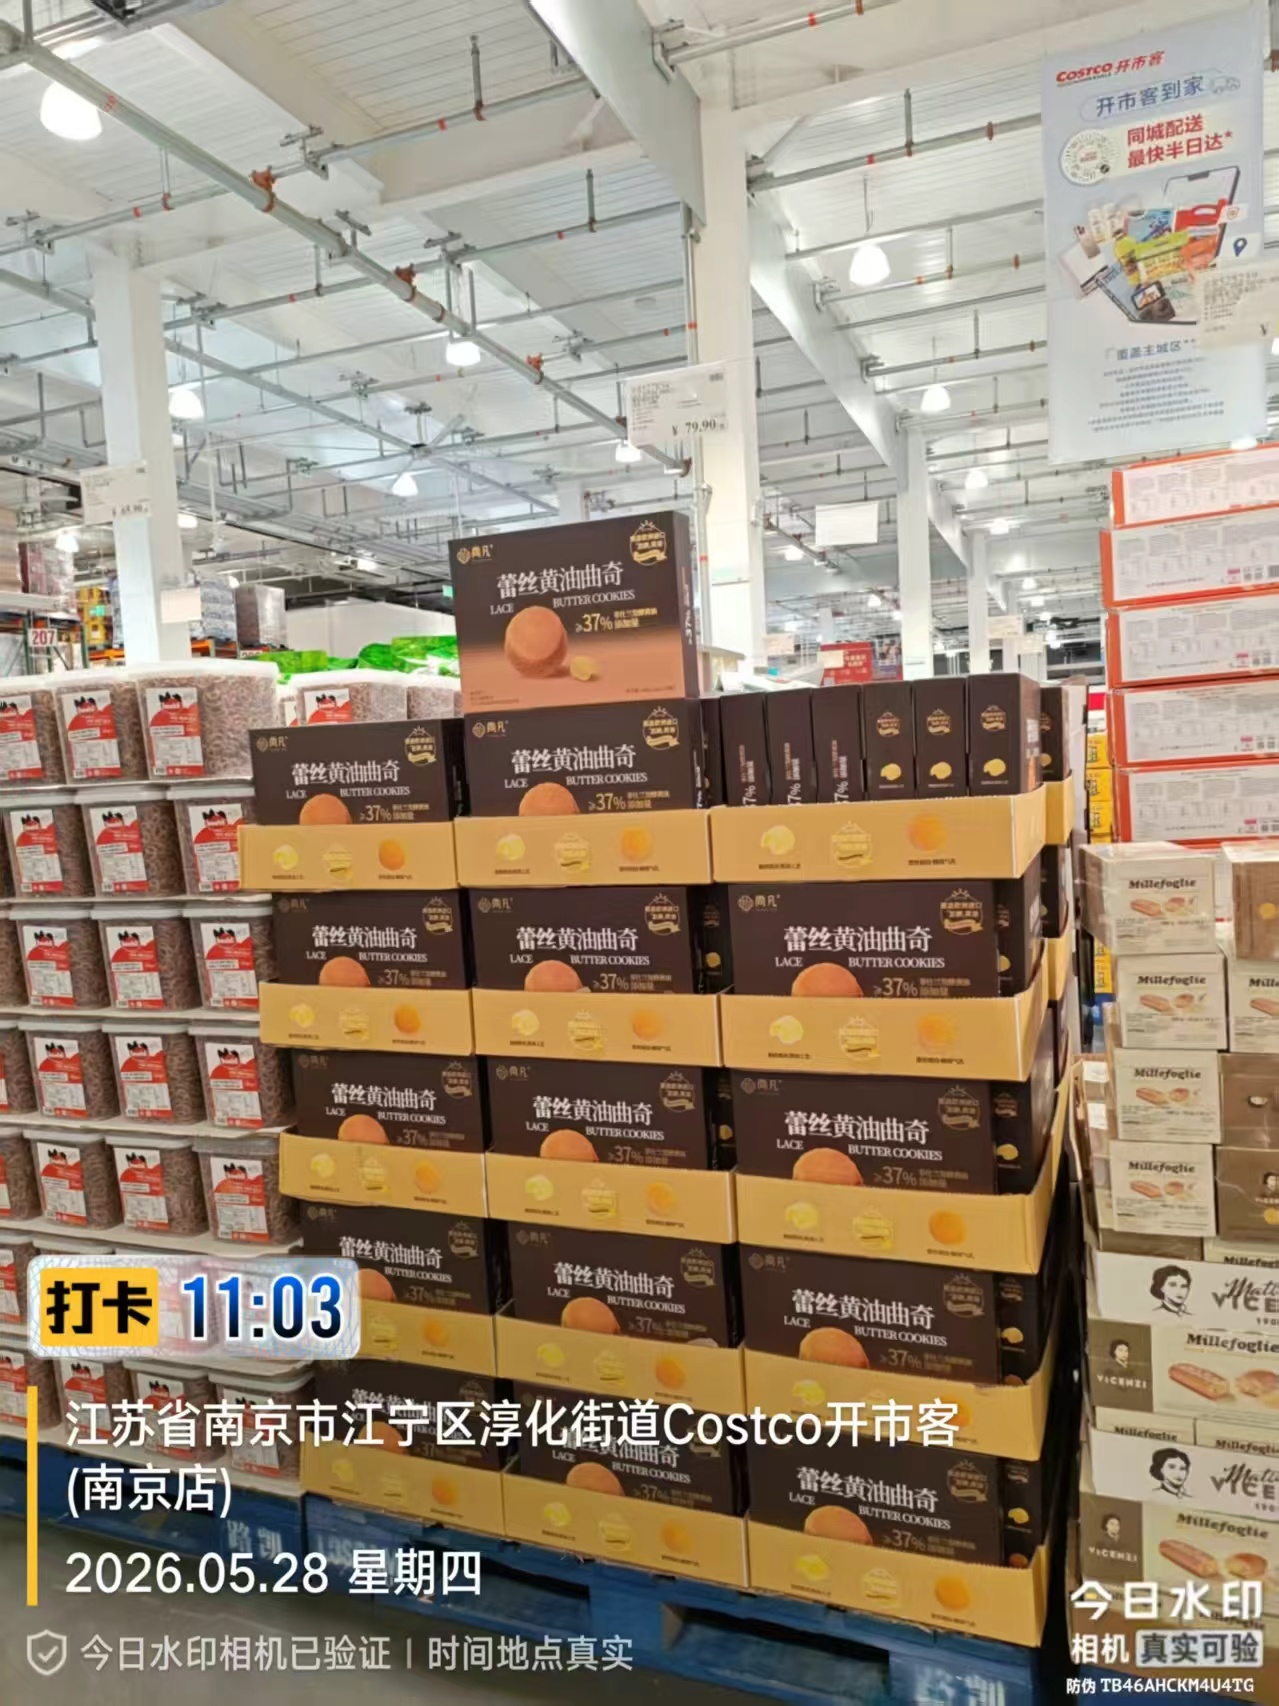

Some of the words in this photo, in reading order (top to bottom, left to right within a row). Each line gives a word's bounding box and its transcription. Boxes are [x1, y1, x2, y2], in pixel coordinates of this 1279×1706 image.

[1115, 50, 1165, 74] 开市客
[1096, 76, 1204, 117] 开市客到家
[1127, 114, 1204, 146] 同城配送
[685, 419, 716, 433] 79.90
[497, 561, 624, 600] 蕾丝黄油曲奇
[490, 602, 514, 616] LACE
[553, 594, 591, 609] BUTTER
[592, 589, 635, 604] COOKIES
[32, 630, 55, 645] 207
[511, 744, 636, 774] 蕾丝黄油曲奇
[292, 759, 400, 786] 蕾丝黄油曲奇
[504, 778, 528, 789] LACE
[566, 774, 605, 786] BUTTER
[605, 772, 648, 785] COOKIES
[286, 789, 307, 800] LACE
[340, 787, 373, 798] BUTTER
[373, 786, 410, 797] COOKIES
[742, 785, 757, 804] 7%
[787, 783, 801, 804] 7%
[834, 781, 849, 803] 7%
[1129, 878, 1196, 890] Millefoglie
[312, 925, 417, 949] 蕾丝黄油曲奇
[516, 926, 639, 951] 蕾丝黄油曲奇
[784, 926, 932, 952] 蕾丝黄油曲奇
[306, 950, 327, 960] LACE
[359, 951, 391, 962] BUTTER
[392, 952, 428, 963] COOKIES
[509, 953, 533, 964] LACE
[570, 954, 608, 965] BUTTER
[609, 955, 650, 966] COOKIES
[775, 957, 803, 968] LACE
[848, 957, 893, 968] BUTTER
[894, 957, 945, 969] COOKIES
[1137, 975, 1206, 987] Millefoglie
[1134, 1067, 1201, 1080] Millefoglie
[332, 1082, 437, 1111] 蕾丝黄油曲奇
[326, 1107, 346, 1117] LACE
[377, 1111, 410, 1122] BUTTER
[410, 1113, 446, 1125] COOKIES
[532, 1096, 653, 1126] 蕾丝黄油曲奇
[526, 1121, 549, 1132] LACE
[586, 1126, 623, 1138] BUTTER
[624, 1129, 665, 1141] COOKIES
[784, 1110, 929, 1145] 蕾丝黄油曲奇
[777, 1138, 803, 1150] LACE
[848, 1144, 892, 1158] BUTTER
[893, 1148, 943, 1161] COOKIES
[1128, 1161, 1195, 1173] Millefoglie
[339, 1236, 443, 1269] 蕾丝黄油曲奇
[554, 1262, 675, 1299] 蕾丝黄油曲奇
[547, 1287, 570, 1298] LACE
[607, 1295, 645, 1309] BUTTER
[645, 1300, 686, 1315] COOKIES
[792, 1288, 935, 1331] 蕾丝黄油曲奇
[784, 1315, 811, 1329] LACE
[854, 1325, 898, 1341] BUTTER
[899, 1331, 947, 1347] COOKIES
[1186, 1333, 1279, 1353] Millefoglie
[1097, 1374, 1147, 1389] VICENZI
[552, 1450, 576, 1462] LACE
[612, 1461, 650, 1477] BUTTER
[650, 1468, 691, 1484] COOKIES
[796, 1466, 939, 1514] 蕾丝黄油曲奇
[789, 1492, 815, 1506] LACE
[858, 1505, 901, 1522] BUTTER
[902, 1513, 951, 1531] COOKIES
[1176, 1513, 1269, 1539] Millefoglie
[1088, 1546, 1138, 1563] VICENZI
